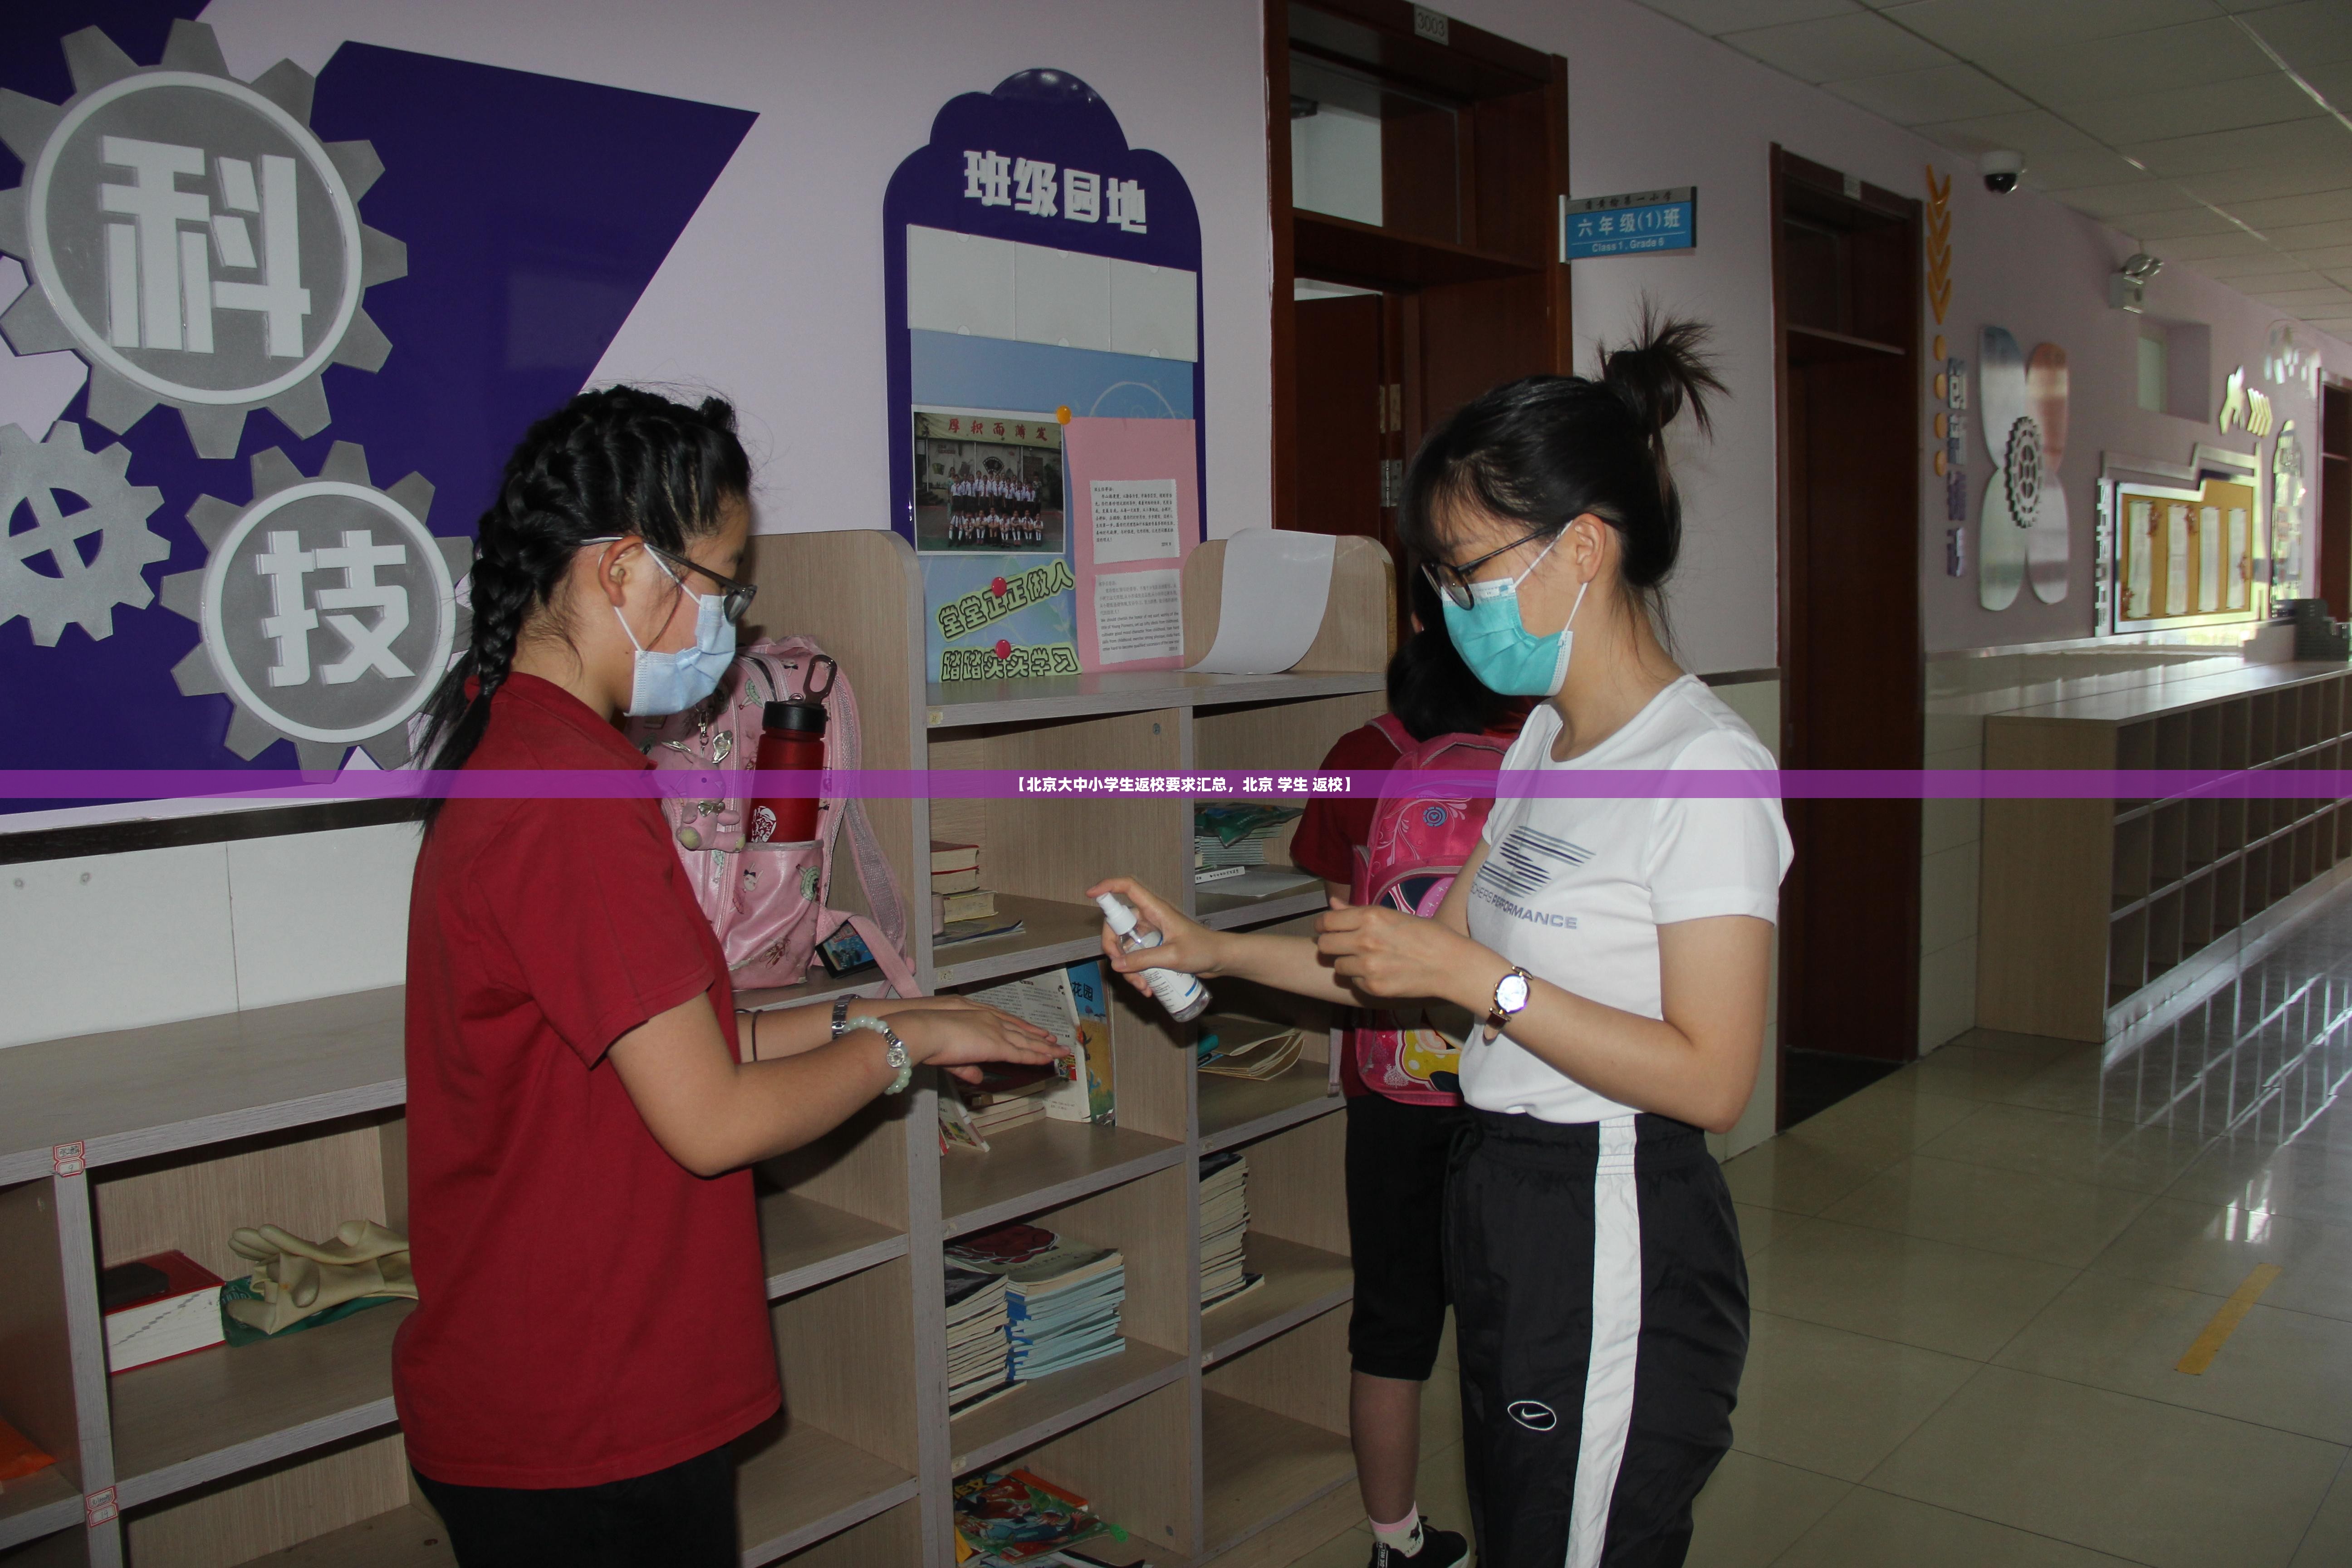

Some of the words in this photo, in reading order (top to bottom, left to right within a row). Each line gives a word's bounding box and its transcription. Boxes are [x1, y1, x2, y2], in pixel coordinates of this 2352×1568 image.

[1416, 12, 1446, 36] 3003
[963, 150, 1147, 235] 班级园地
[1577, 207, 1681, 237] 六年级(1)班
[98, 134, 311, 358] 科
[1592, 241, 1617, 253] Class
[1630, 238, 1656, 249] Grade
[948, 417, 1048, 442] 厚积而薄发
[255, 529, 416, 688] 技
[939, 561, 1074, 637] 堂堂正正做人
[941, 647, 1078, 682] 踏踏实实学习
[1491, 894, 1578, 930] PERFORMANCE
